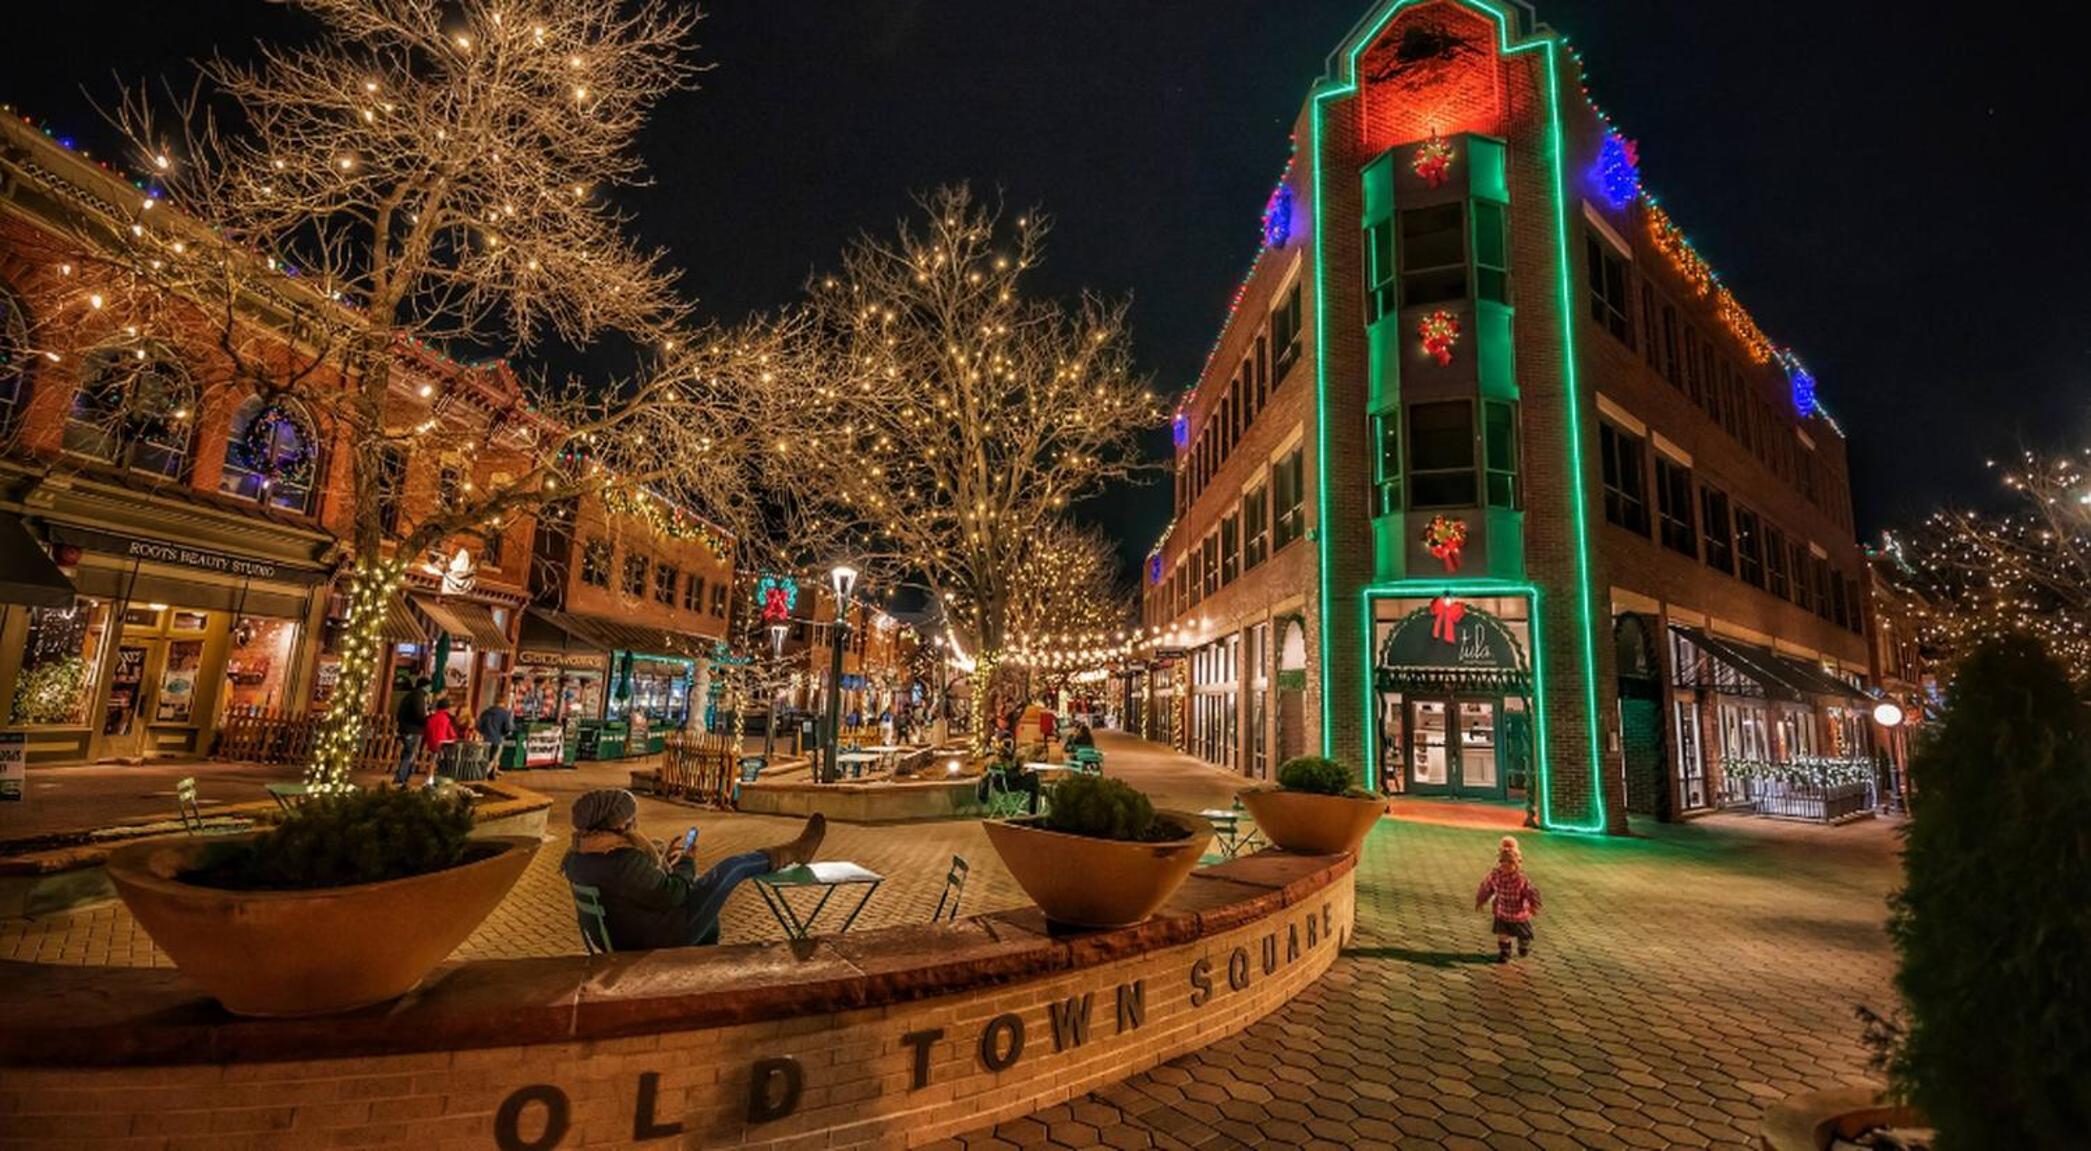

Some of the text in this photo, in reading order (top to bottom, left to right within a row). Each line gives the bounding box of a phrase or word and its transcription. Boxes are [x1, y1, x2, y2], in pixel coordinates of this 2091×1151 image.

[129, 541, 276, 578] ROOTS BEAUTY STUDIO
[1459, 622, 1491, 661] tula
[494, 902, 1334, 1151] OLD TOWN SQUARE
